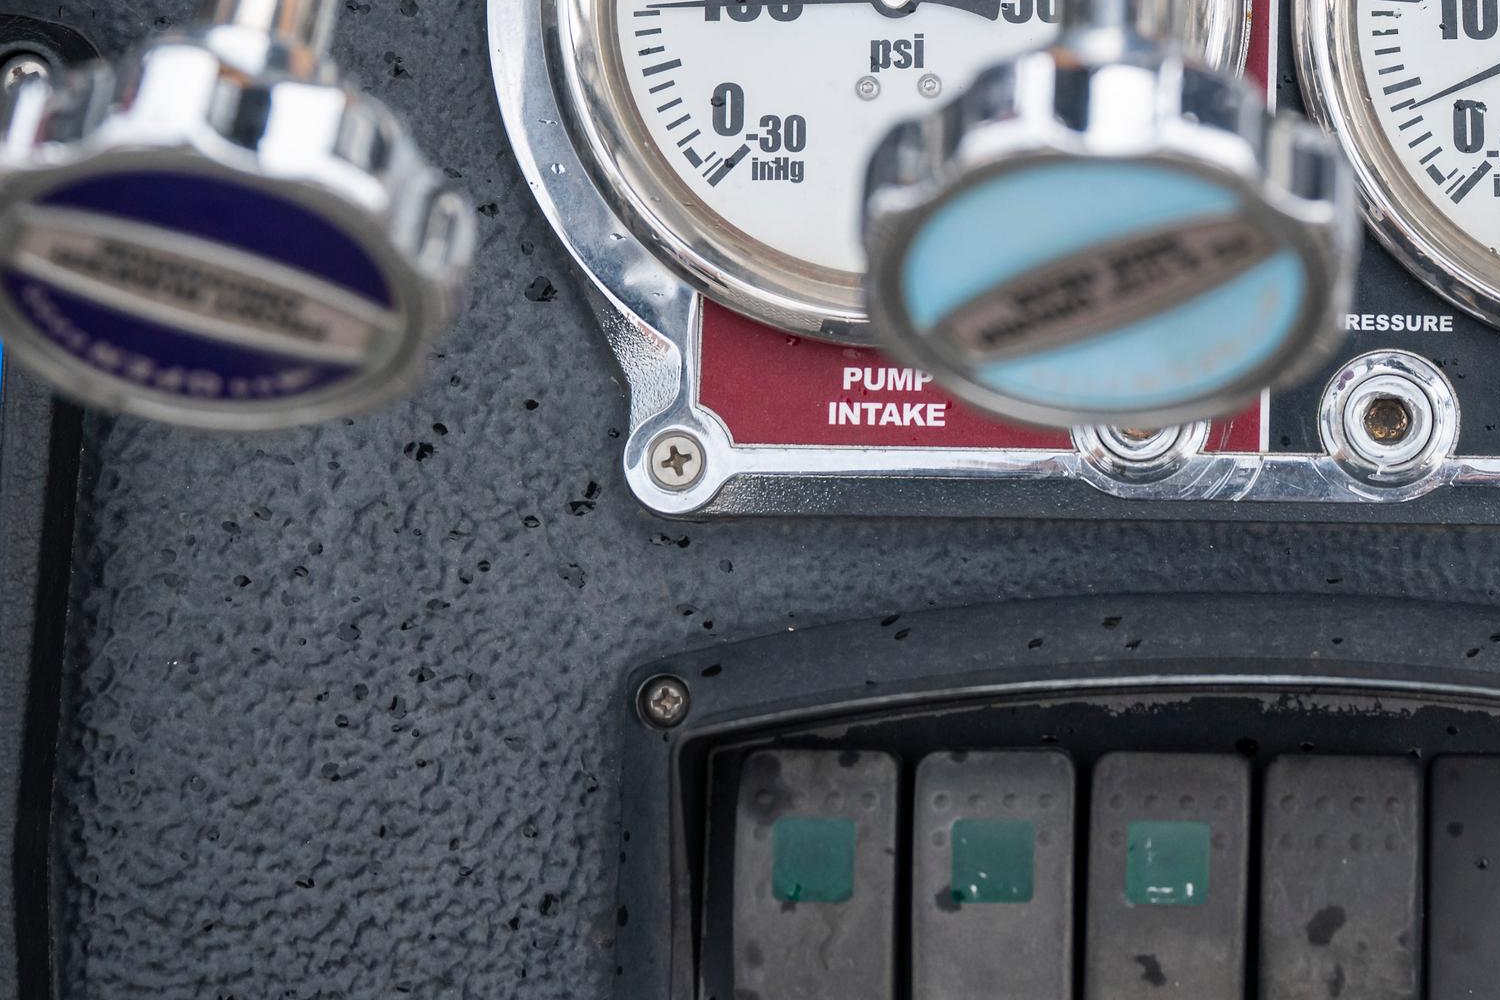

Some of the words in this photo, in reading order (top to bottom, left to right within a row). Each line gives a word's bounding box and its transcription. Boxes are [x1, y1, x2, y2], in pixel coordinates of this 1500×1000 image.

[870, 34, 924, 72] psi
[711, 82, 744, 136] 0
[746, 113, 808, 152] -30
[1453, 99, 1487, 153] 0
[752, 157, 804, 183] inHg
[1345, 313, 1454, 332] RESSURE
[842, 366, 934, 392] PUMP
[829, 402, 946, 426] INTAKE
